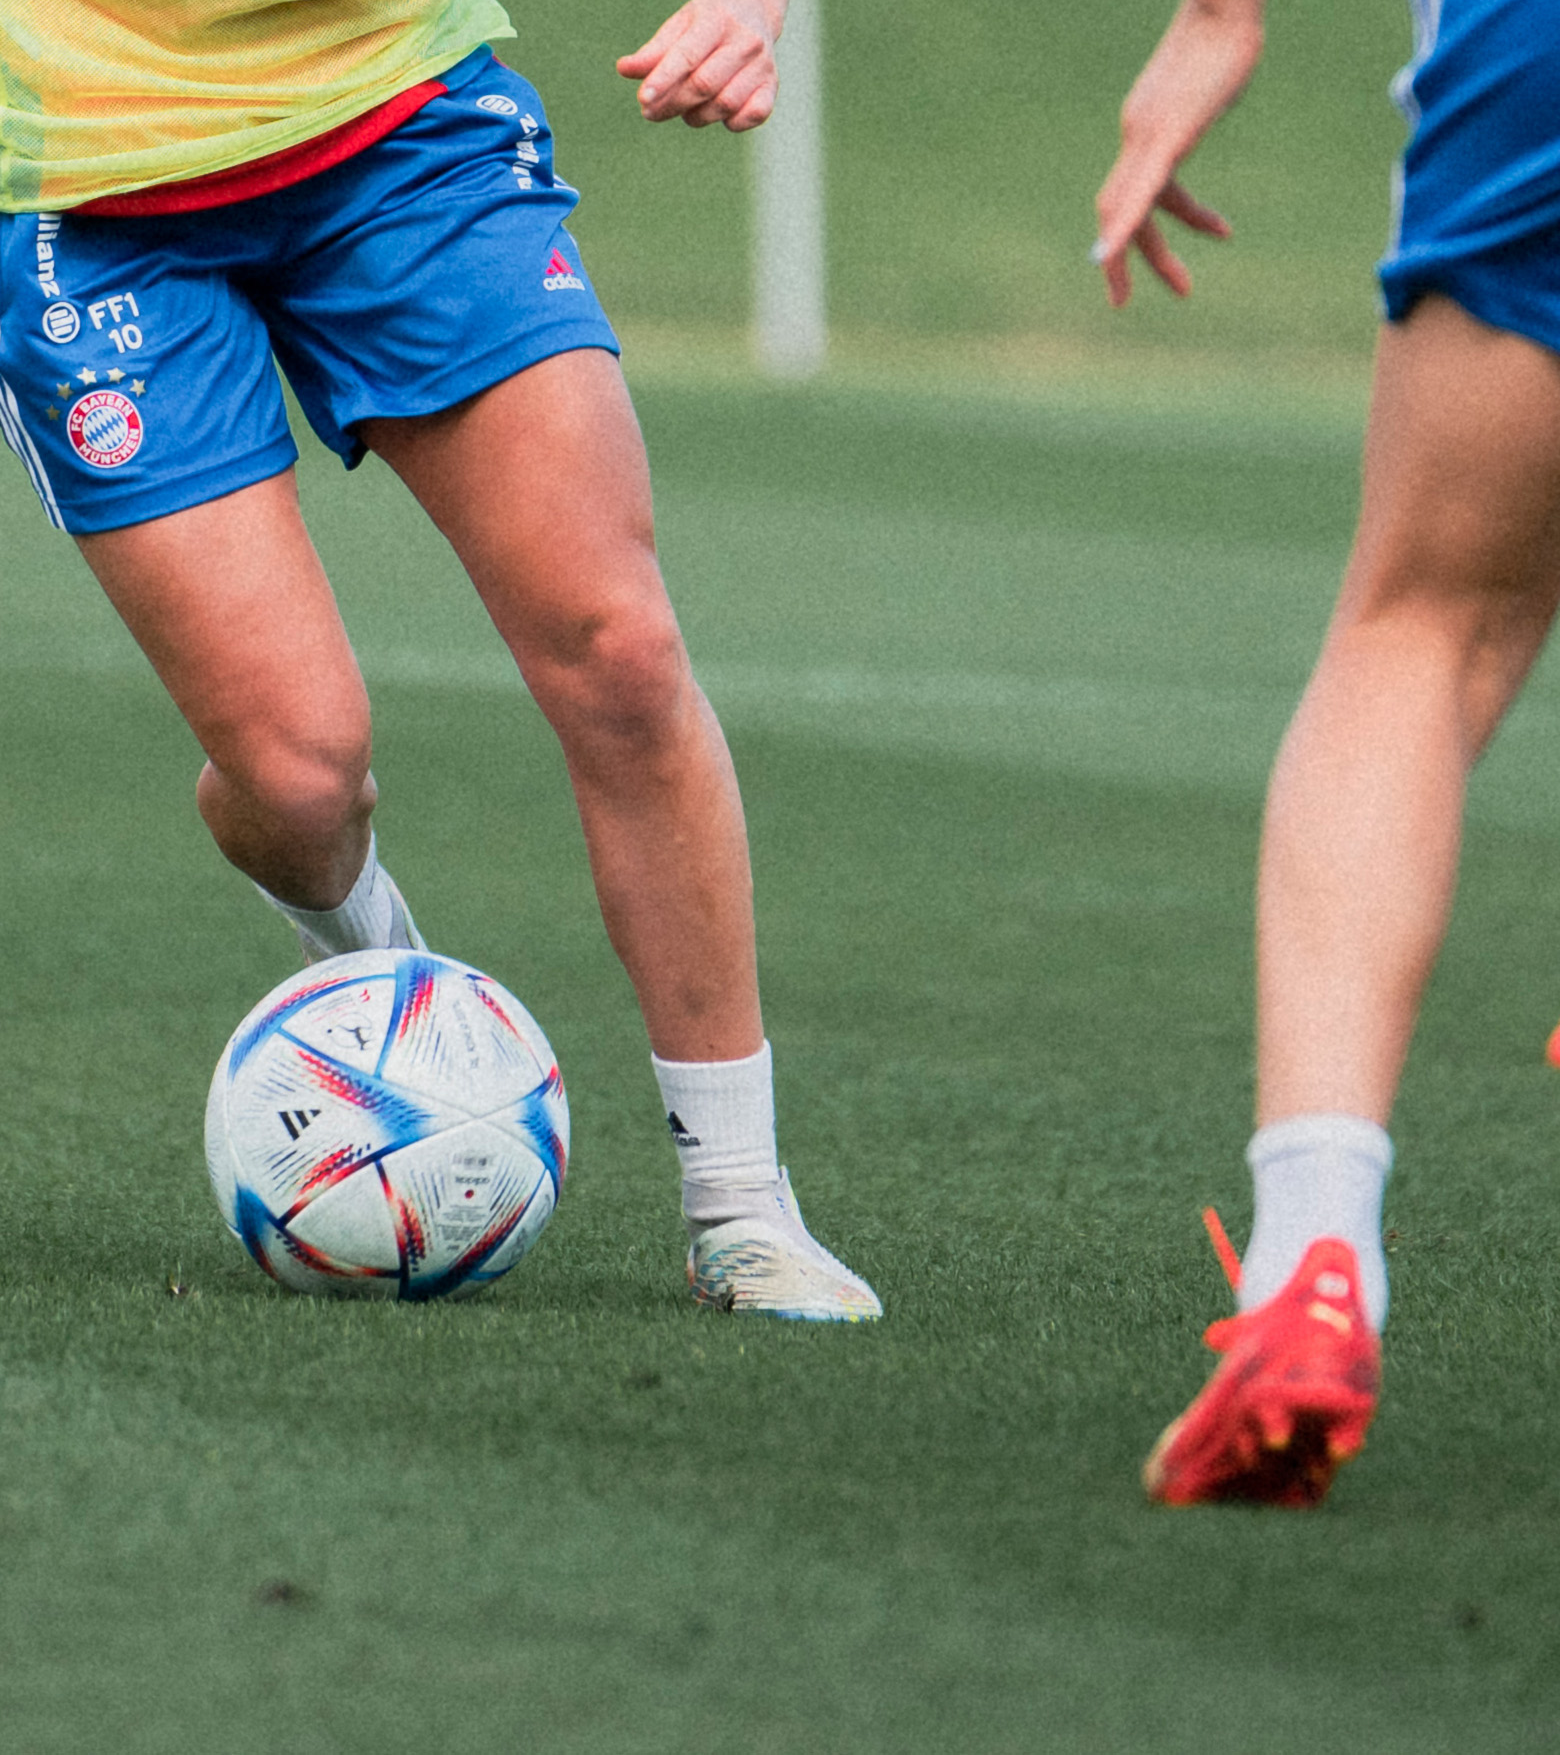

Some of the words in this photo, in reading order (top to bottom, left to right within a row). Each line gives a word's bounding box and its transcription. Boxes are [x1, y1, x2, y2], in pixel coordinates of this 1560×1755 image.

[35, 213, 62, 298] llianz
[87, 292, 140, 330] FF1
[108, 323, 143, 354] 10
[71, 412, 84, 432] FC
[79, 394, 134, 417] BAYERN
